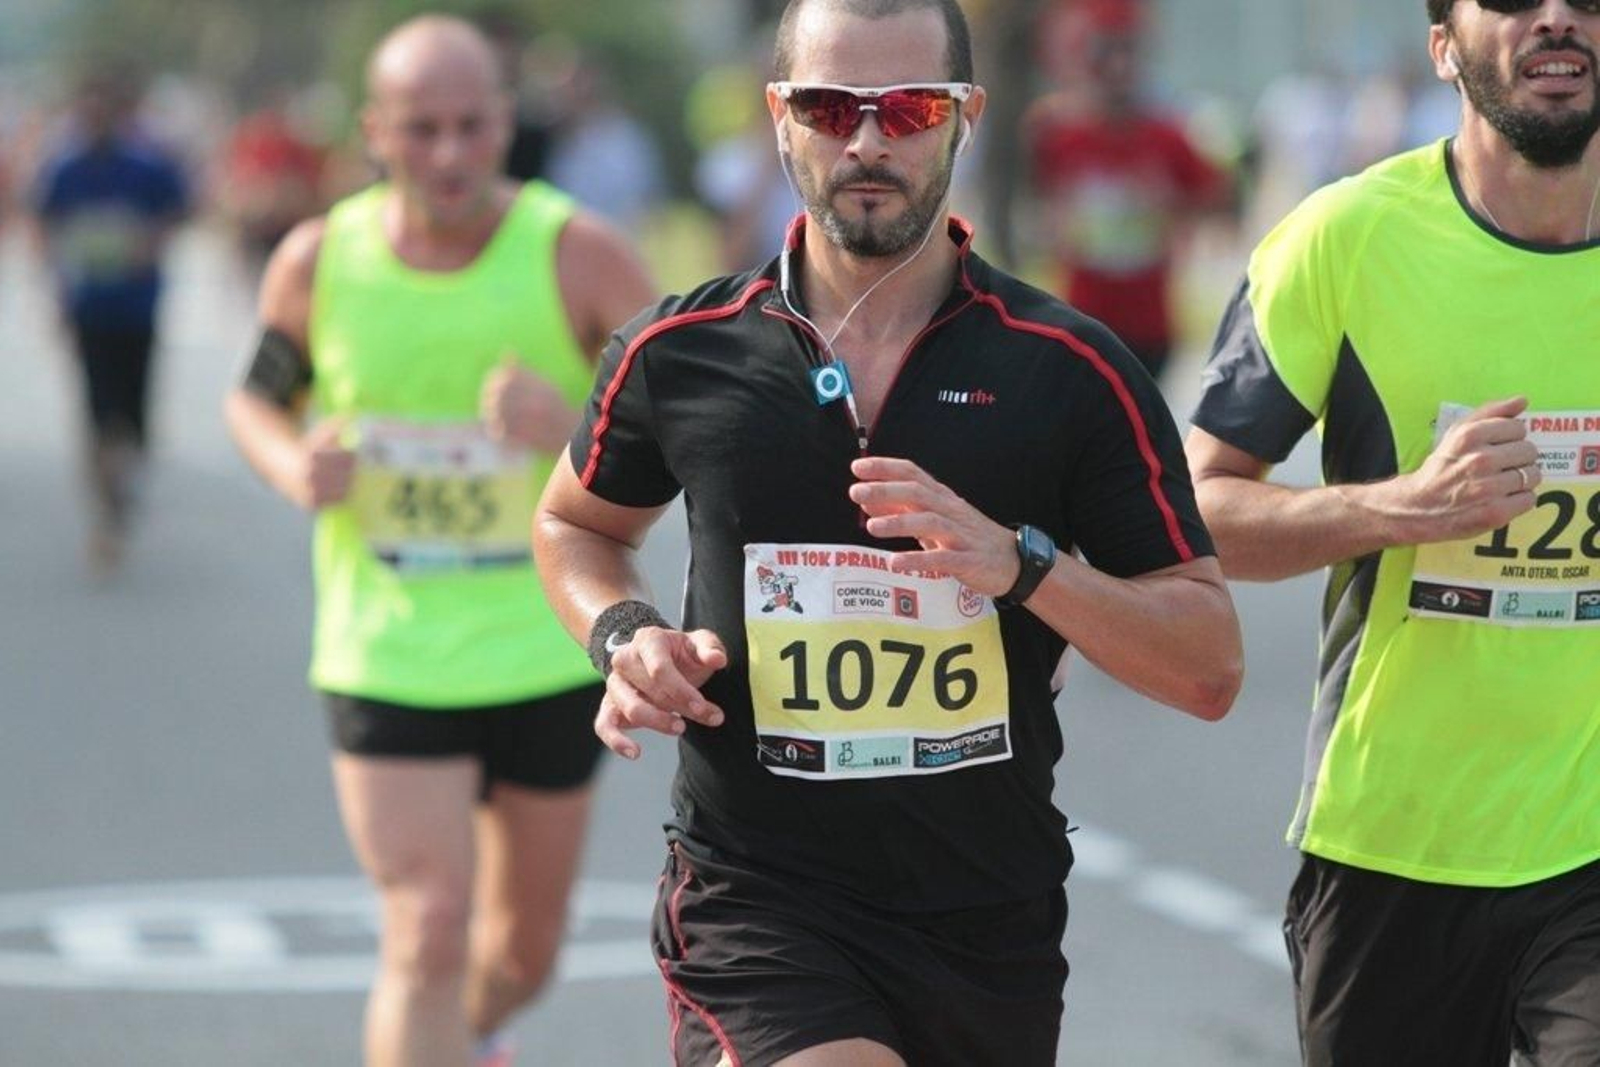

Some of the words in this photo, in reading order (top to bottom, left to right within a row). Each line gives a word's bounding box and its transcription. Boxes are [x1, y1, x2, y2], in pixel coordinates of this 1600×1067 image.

[1531, 417, 1578, 432] PRAIA
[1537, 450, 1576, 461] NCELLO
[1546, 461, 1570, 471] VIGO
[384, 471, 500, 537] 465
[801, 550, 832, 567] 10K
[835, 551, 889, 572] PRAIA
[1501, 564, 1526, 578] ANTA
[1528, 566, 1559, 580] OTERO,
[1562, 565, 1590, 579] OSCAR
[837, 586, 890, 599] CONCELLO
[843, 598, 857, 607] DE
[860, 598, 885, 608] VIGO
[780, 639, 979, 712] 1076
[917, 728, 1001, 753] POWERADE
